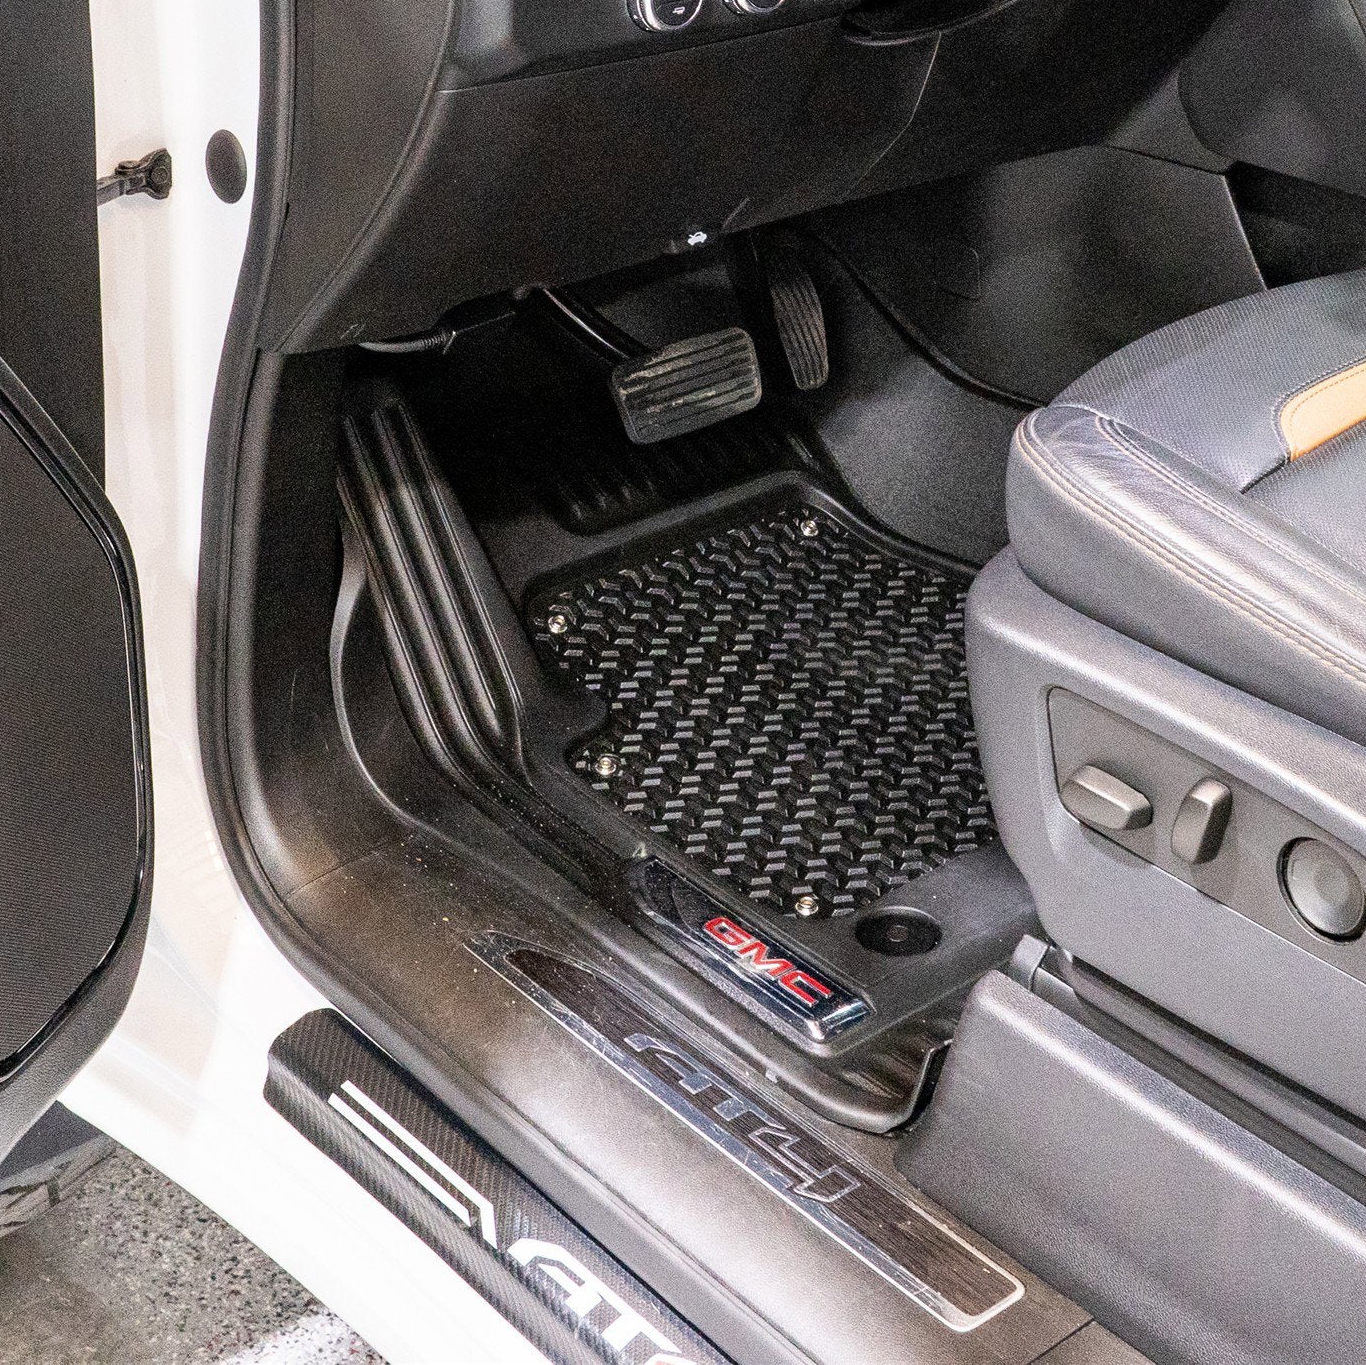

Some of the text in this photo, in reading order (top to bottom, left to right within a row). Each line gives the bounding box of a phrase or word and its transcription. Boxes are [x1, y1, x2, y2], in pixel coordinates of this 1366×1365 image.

[702, 916, 833, 1008] GMC
[623, 1032, 862, 1202] AT4
[506, 1237, 698, 1365] AT
